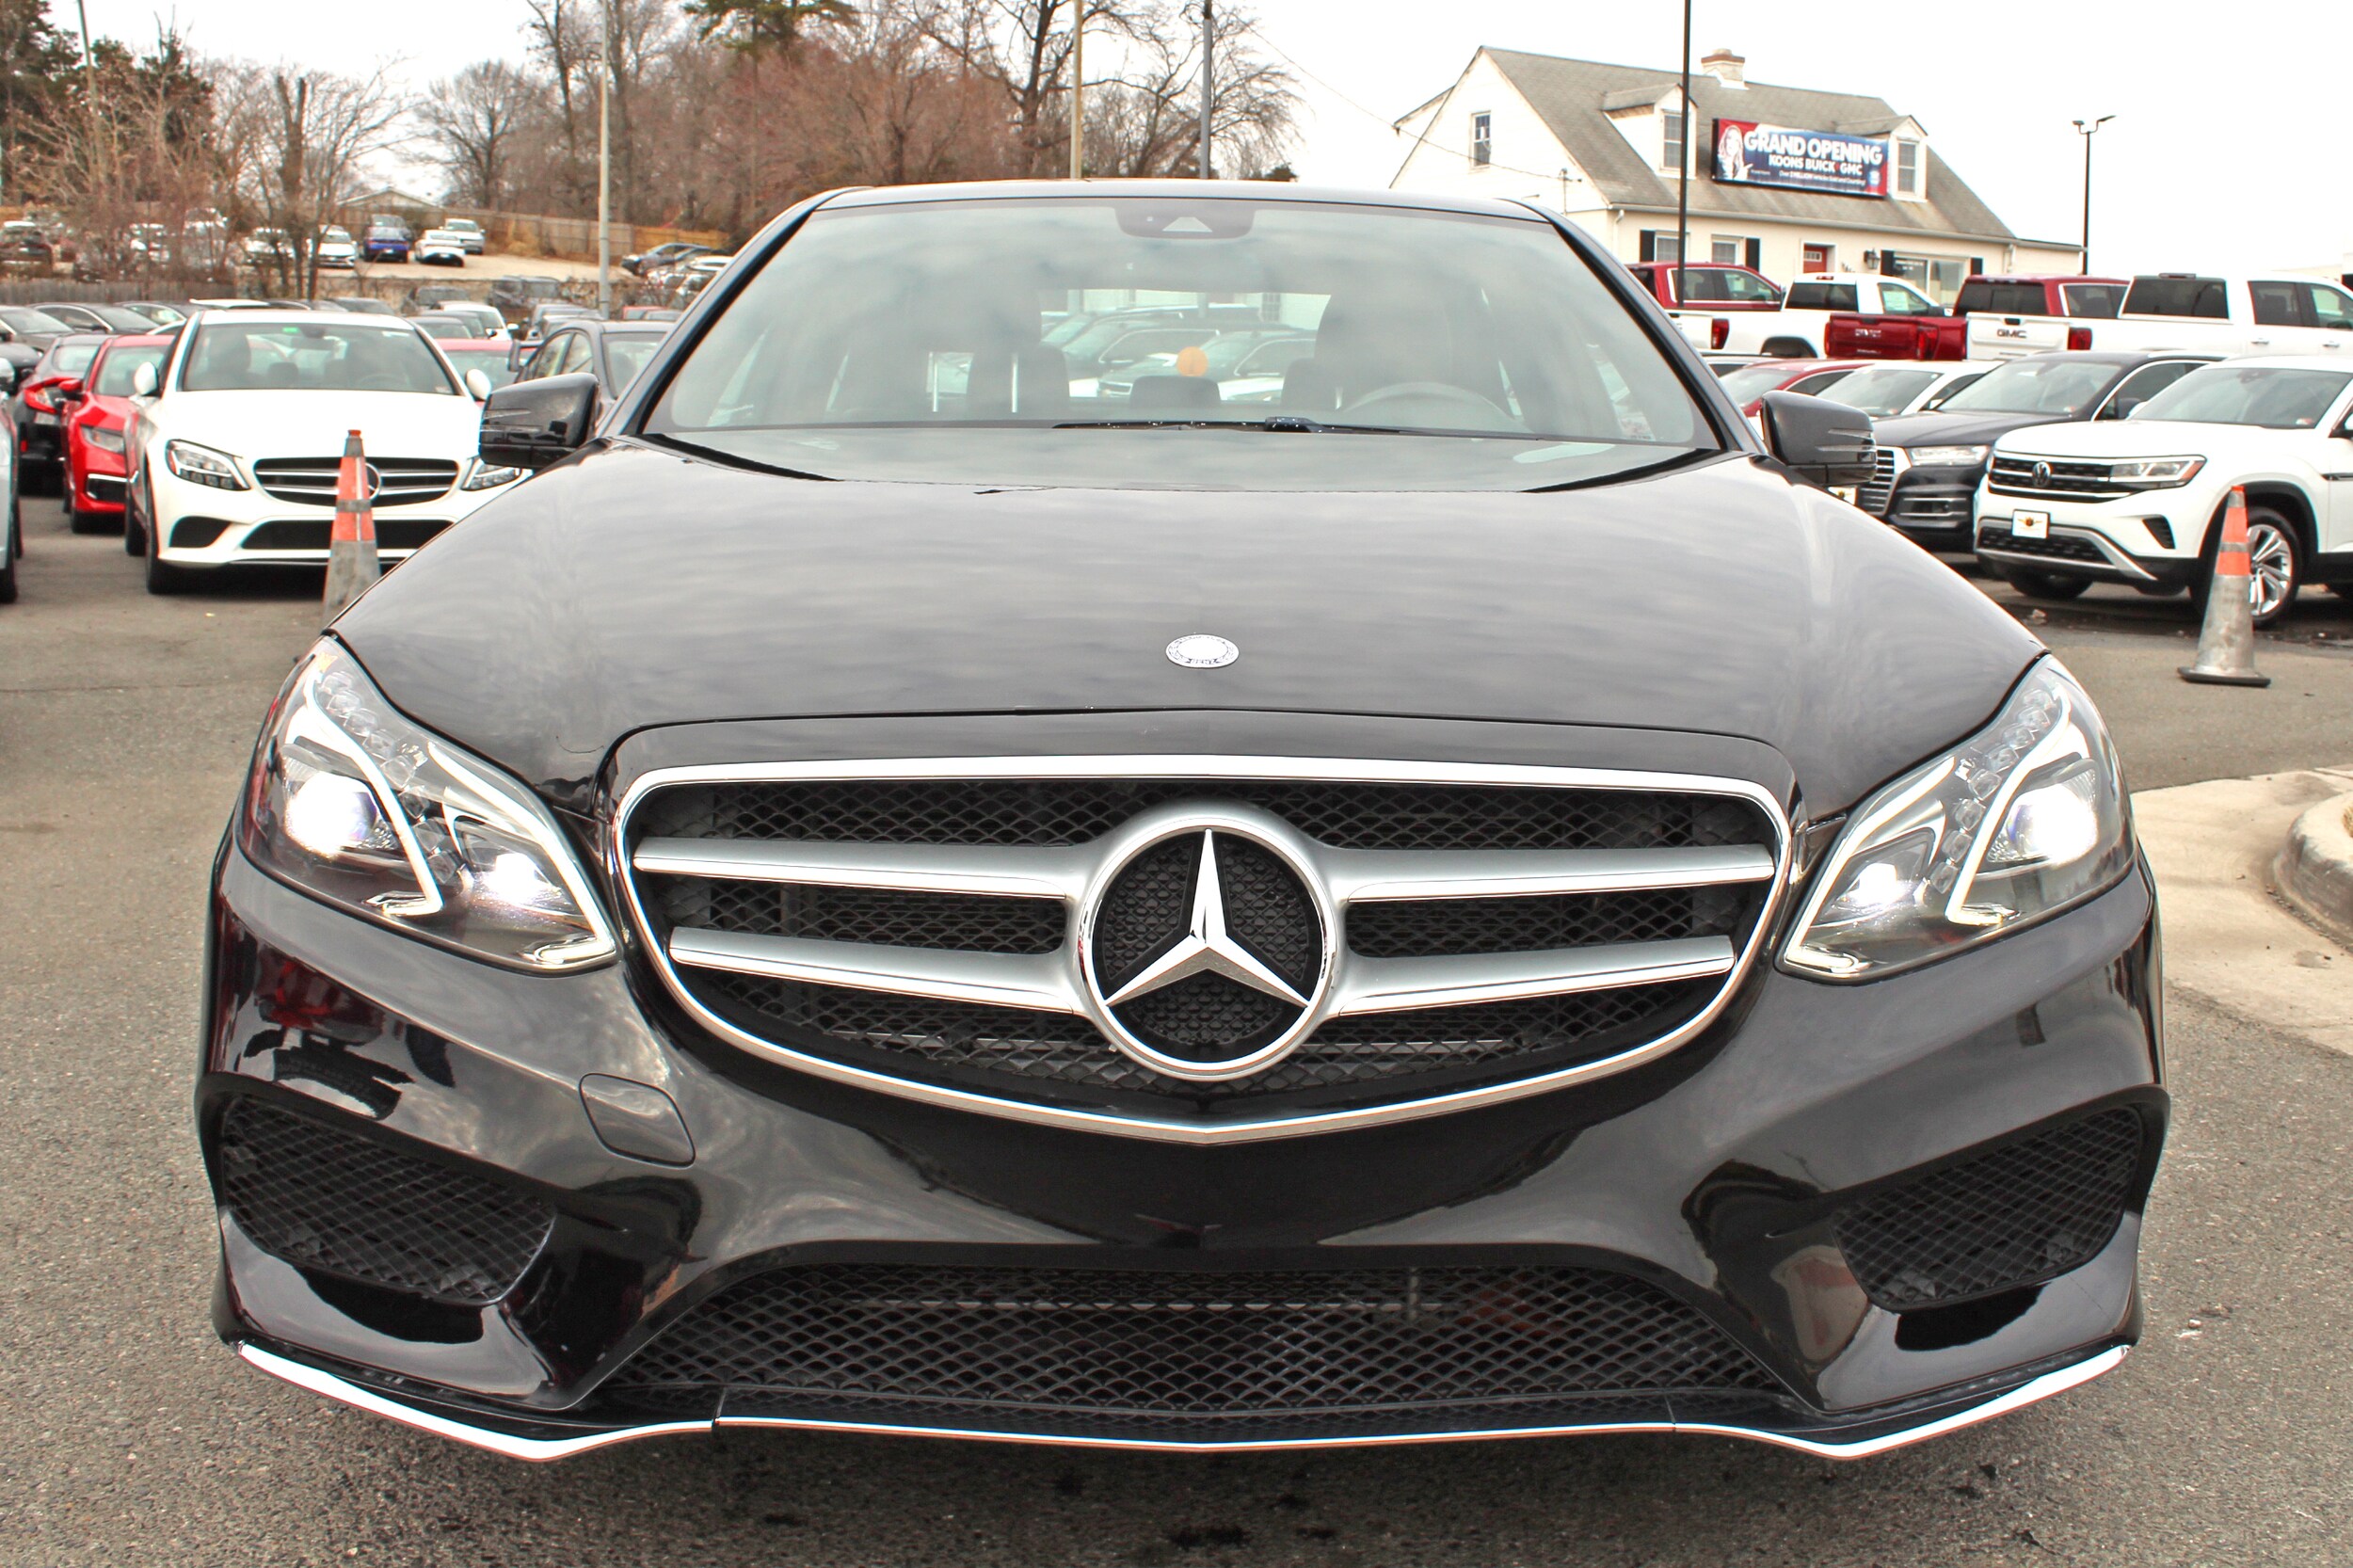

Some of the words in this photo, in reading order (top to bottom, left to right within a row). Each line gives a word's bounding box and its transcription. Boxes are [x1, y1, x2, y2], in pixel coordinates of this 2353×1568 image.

[1744, 131, 1806, 156] GRAND
[1807, 137, 1882, 166] OPENING
[1769, 153, 1804, 168] KOONS
[1805, 158, 1836, 172] BUICK
[1840, 162, 1863, 176] GMC
[1996, 328, 2027, 339] GMC
